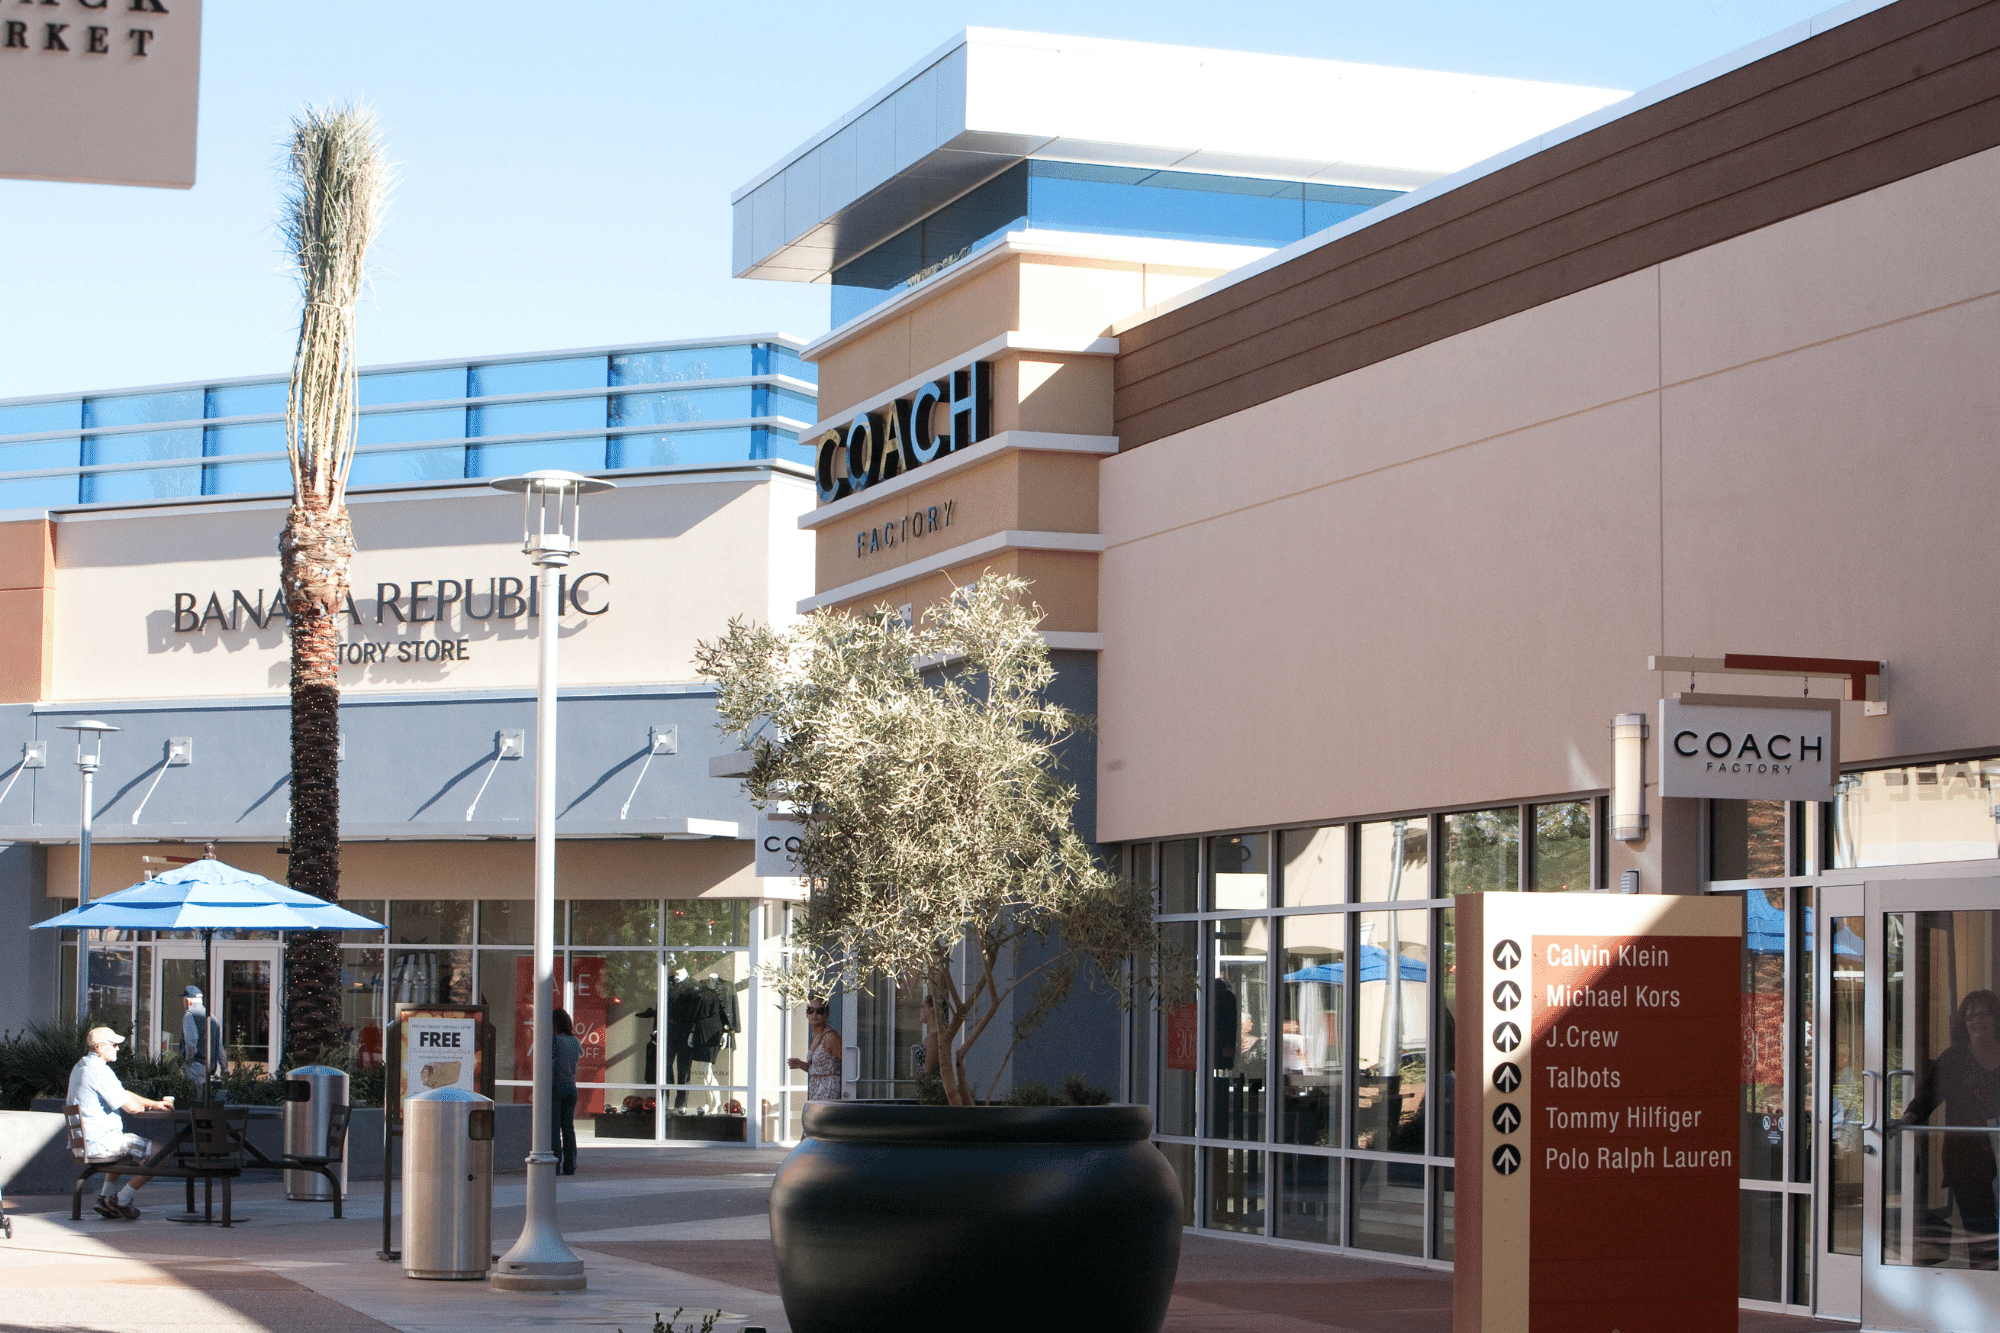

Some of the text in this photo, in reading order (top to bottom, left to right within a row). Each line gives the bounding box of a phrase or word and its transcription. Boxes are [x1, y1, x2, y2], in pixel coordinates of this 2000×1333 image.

[5, 20, 154, 57] RKET
[815, 361, 990, 503] COACH
[856, 499, 954, 558] FACTORY
[174, 587, 364, 632] BANAA
[337, 638, 470, 664] TORY STORE
[1674, 730, 1822, 762] COACH
[1706, 761, 1792, 774] FACTORY
[1547, 943, 1669, 967] Calvin Klein
[1547, 984, 1680, 1007] Michael Kors
[420, 1031, 461, 1047] FREE
[1546, 1025, 1619, 1047] J.Crew
[1546, 1066, 1621, 1088] Talbots
[1545, 1106, 1702, 1133] Tommy Hilfiger
[1546, 1146, 1732, 1173] Polo Ralph Lauren
